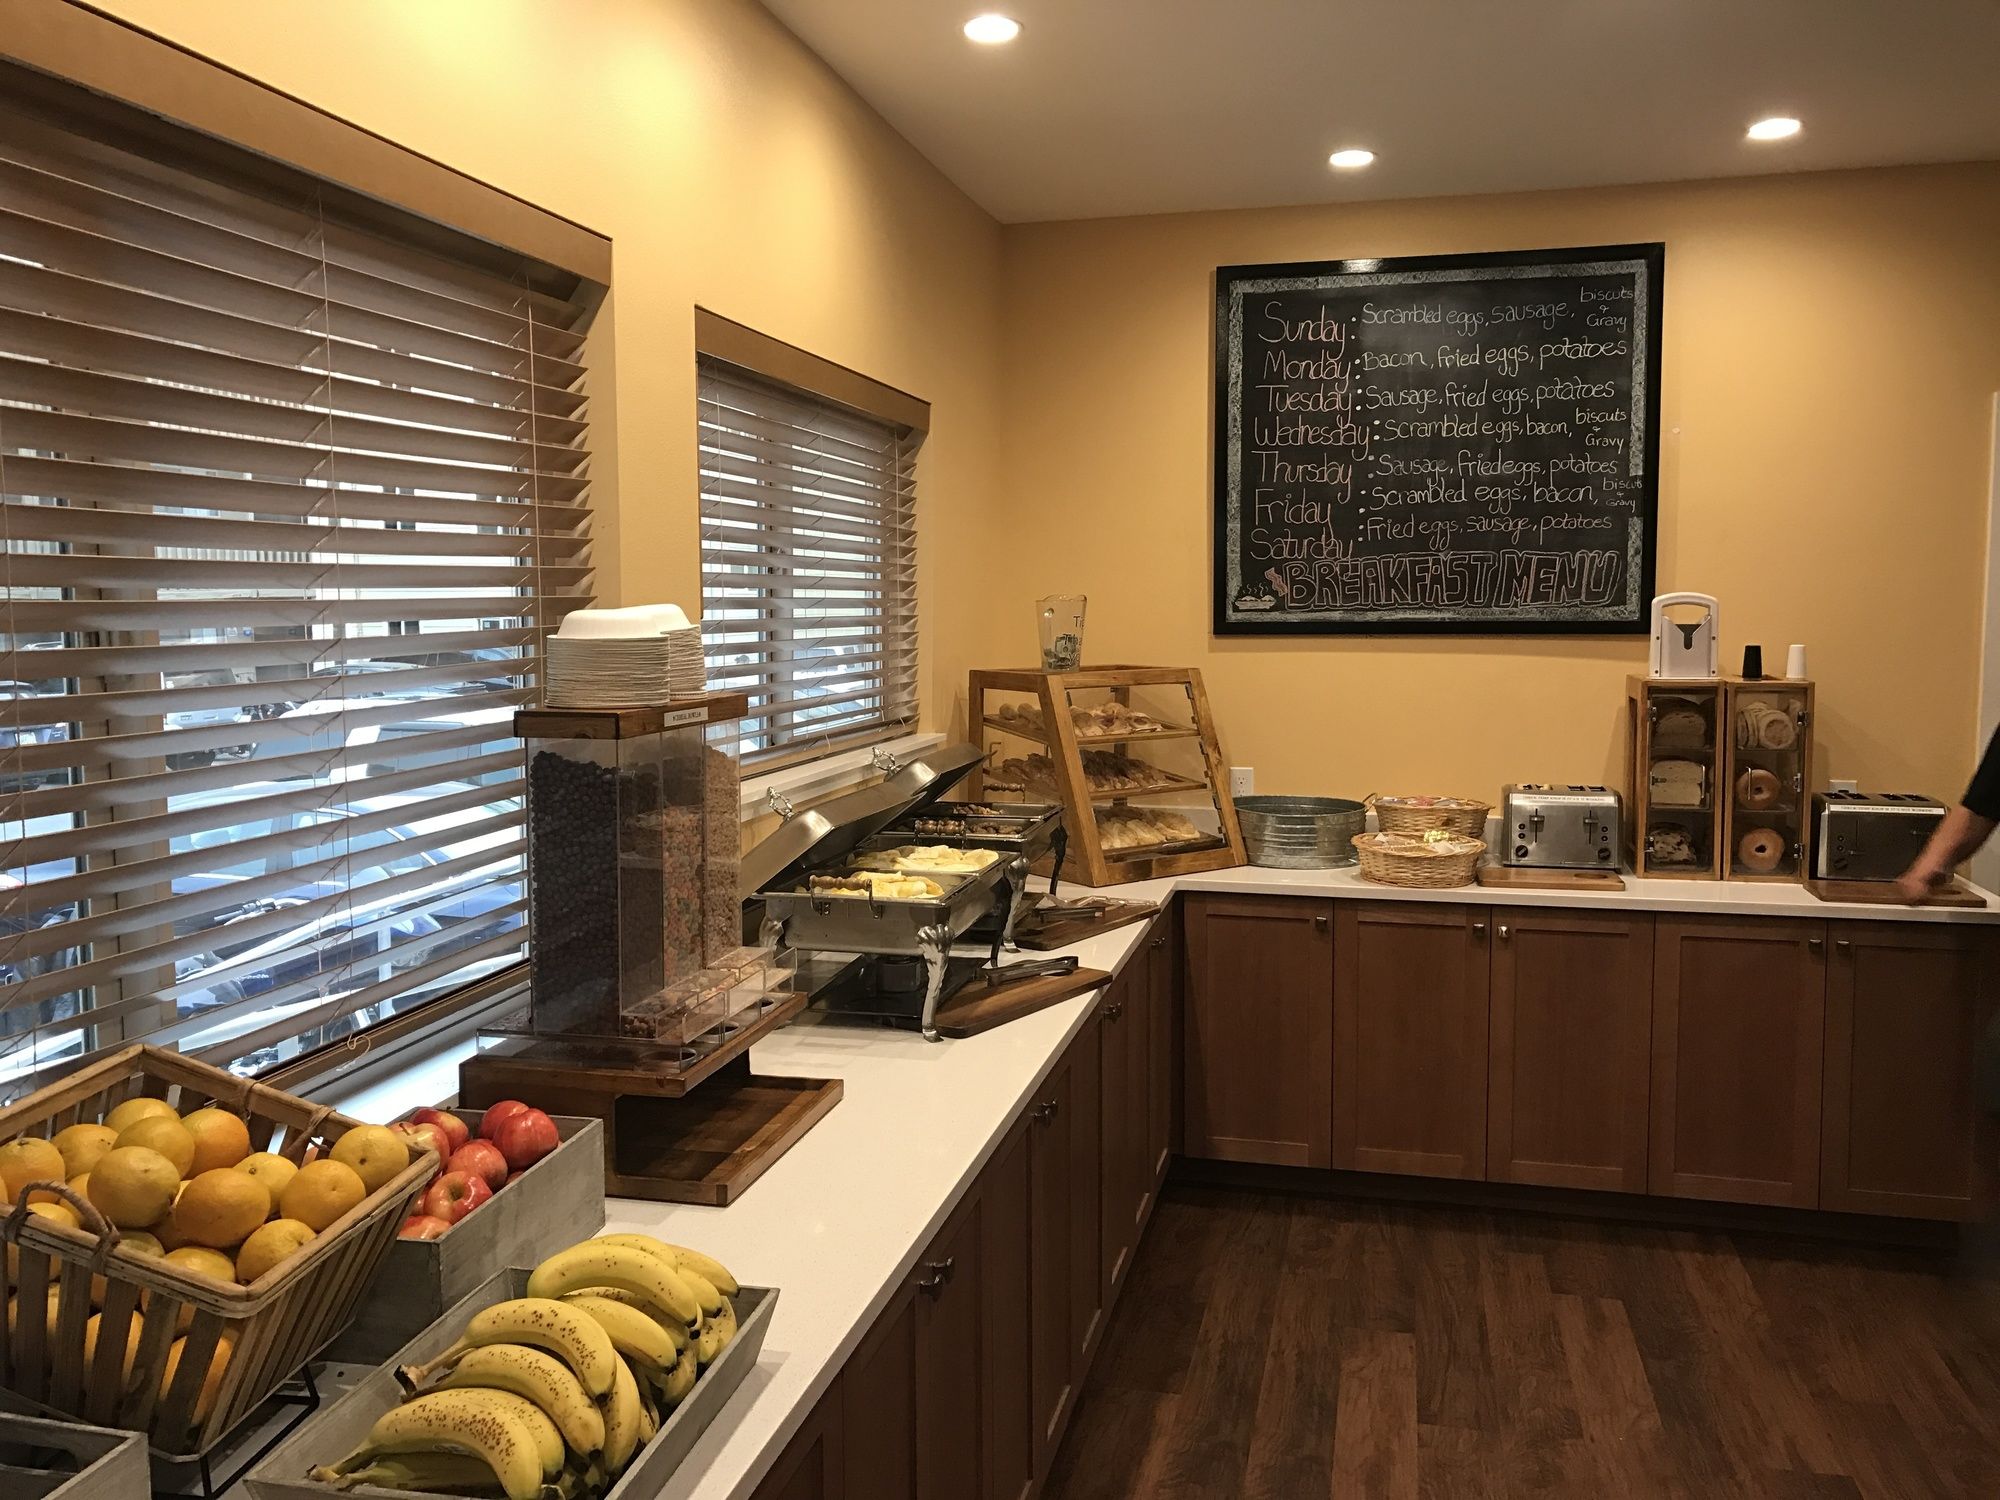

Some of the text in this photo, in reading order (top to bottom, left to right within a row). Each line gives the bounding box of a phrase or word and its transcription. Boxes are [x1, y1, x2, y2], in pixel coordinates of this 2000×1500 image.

[1580, 286, 1634, 303] biscuts
[1362, 303, 1442, 324] Scrambled
[1446, 310, 1489, 336] eggs,
[1586, 313, 1628, 333] Gravy
[1362, 351, 1435, 370] Bacon,
[1485, 345, 1534, 377] eggs,
[1540, 336, 1627, 370] potatoes
[1365, 385, 1442, 413] Sausage,
[1492, 388, 1534, 414] eggs,
[1536, 376, 1615, 409] potatoes
[1384, 412, 1478, 441] Scrambled
[1482, 420, 1524, 443] eggs,
[1526, 413, 1573, 437] bacon,
[1575, 407, 1627, 424] biscuts
[1585, 433, 1625, 454] Gravy
[1376, 454, 1453, 487] Sausage,
[1550, 453, 1618, 489] potatoes
[1370, 477, 1467, 510] Scrambled
[1475, 486, 1526, 514] eggs,
[1533, 481, 1599, 505] bacon,
[1367, 513, 1415, 540] Fried
[1419, 521, 1463, 550] eggs,
[1540, 513, 1613, 545] potatoes
[1283, 550, 1622, 610] BREAKFAST MENU
